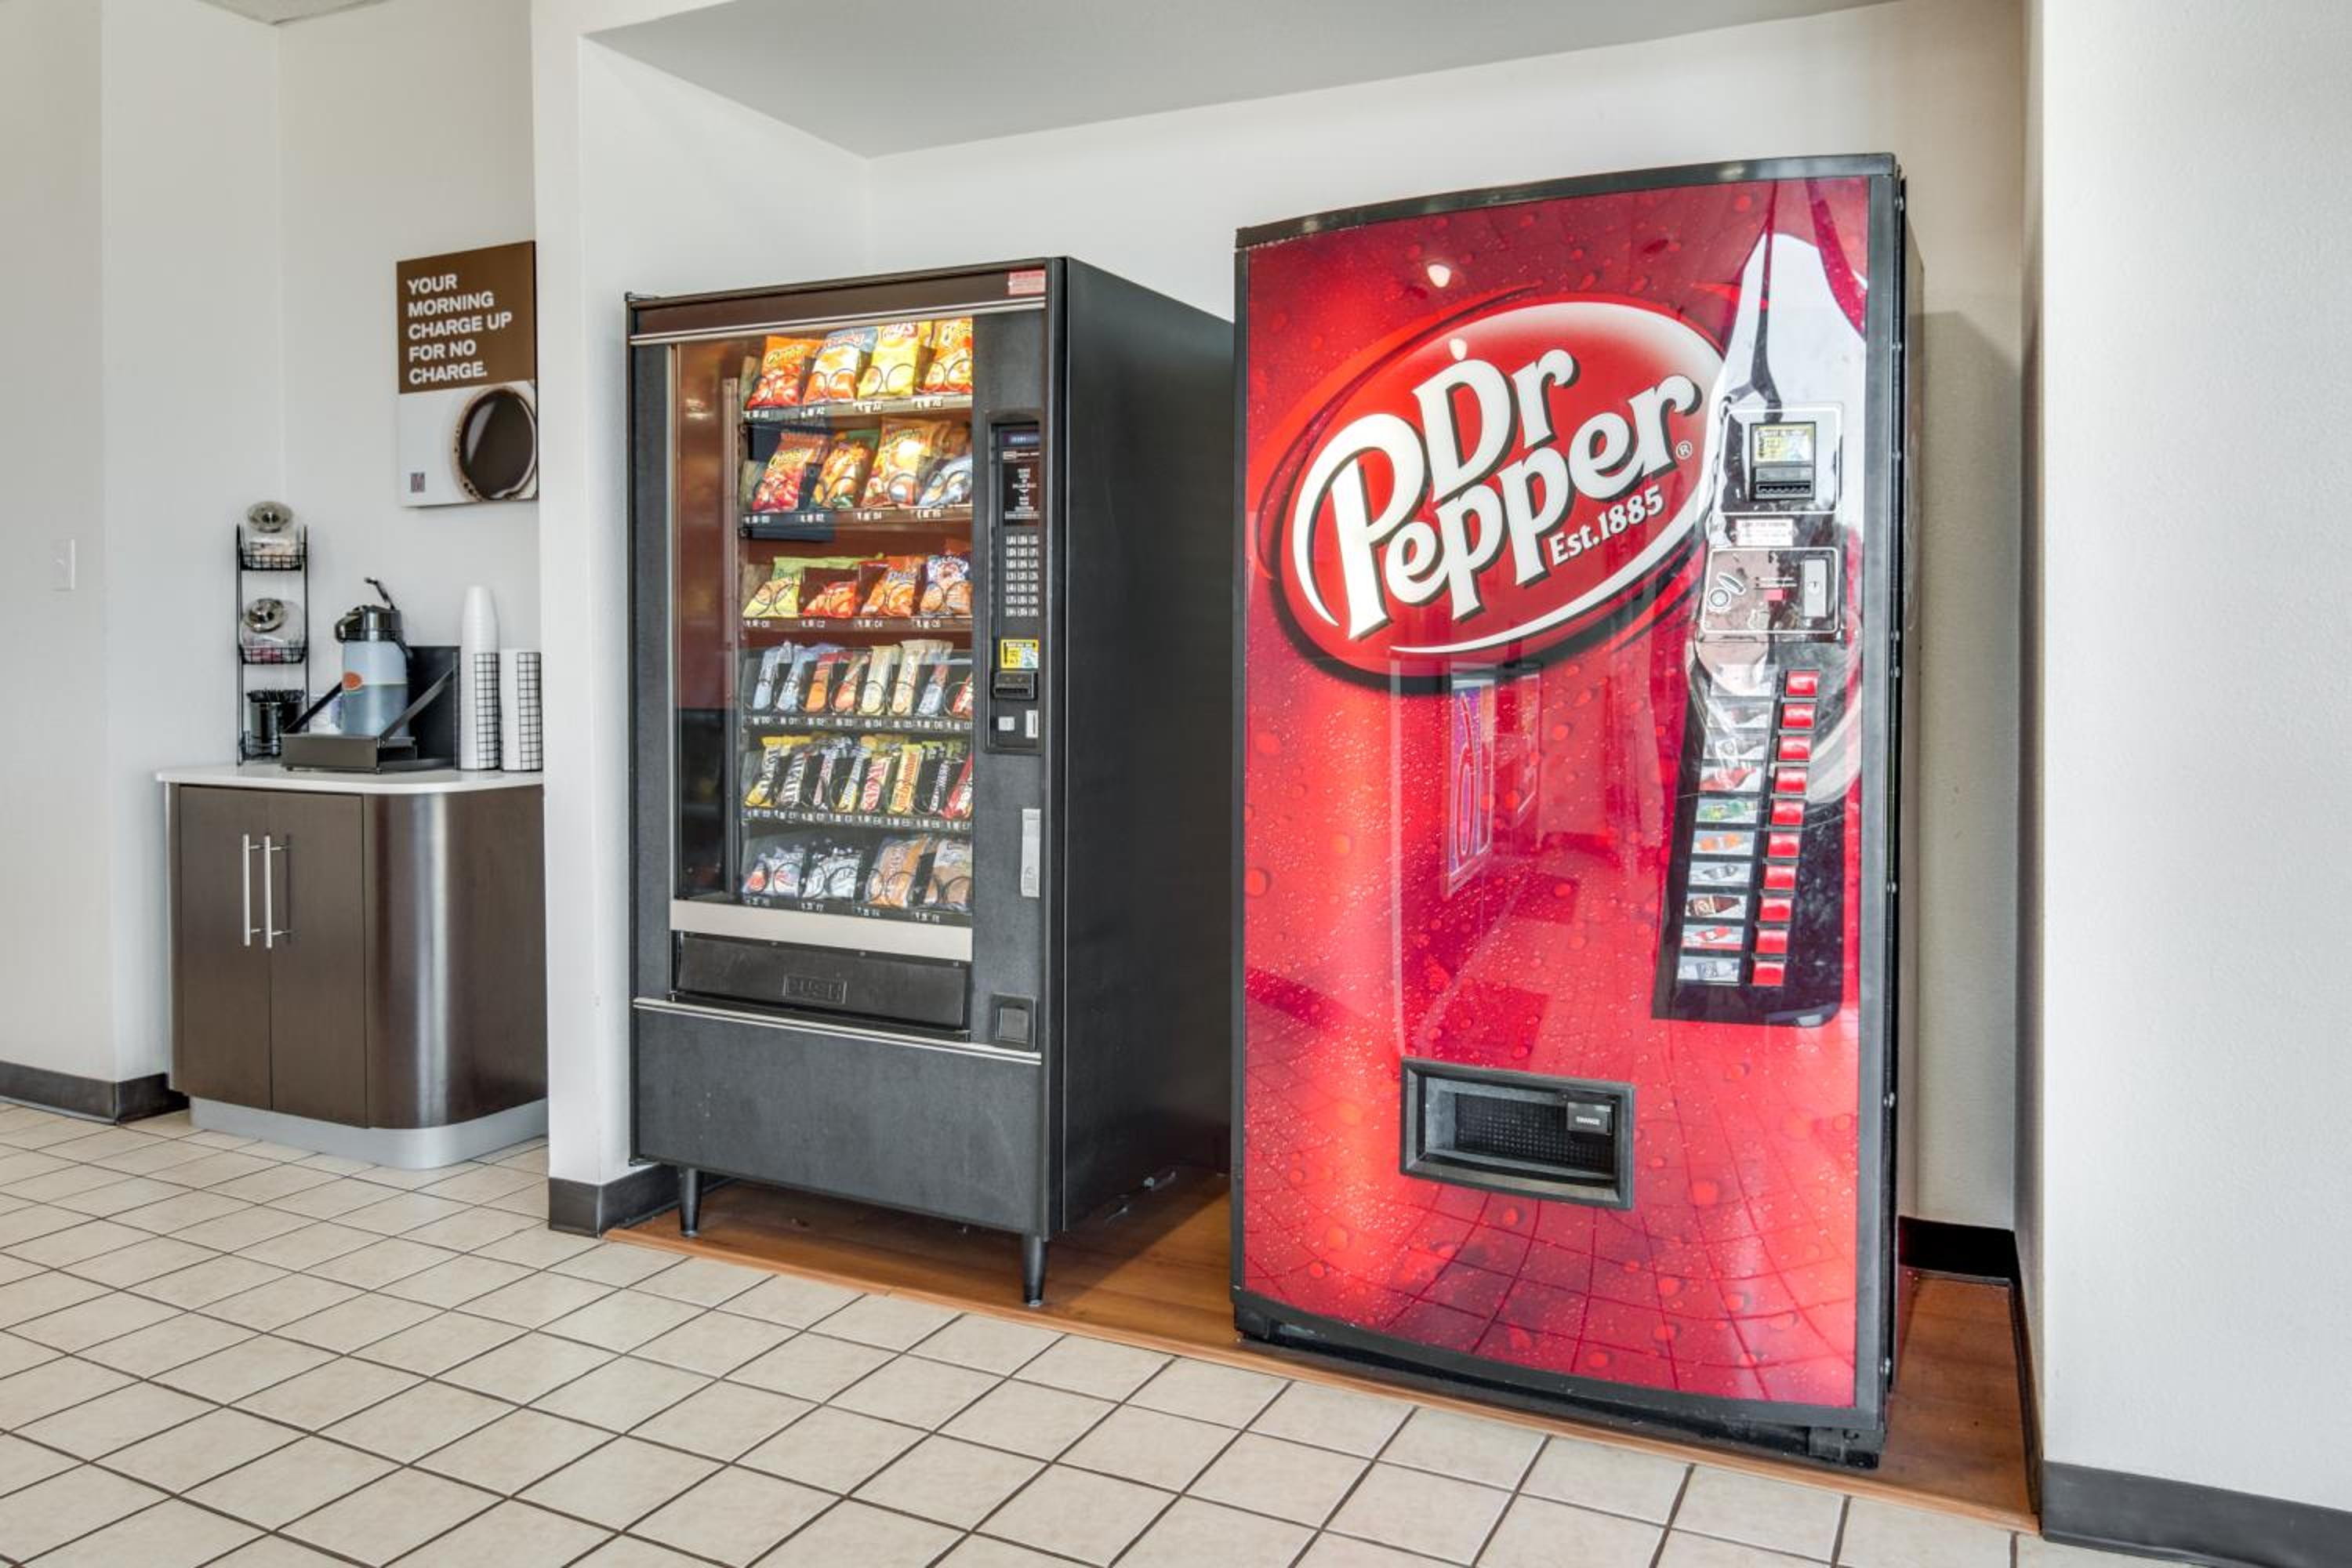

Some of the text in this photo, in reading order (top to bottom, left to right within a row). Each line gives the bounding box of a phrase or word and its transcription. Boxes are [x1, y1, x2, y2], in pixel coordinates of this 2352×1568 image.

[407, 274, 457, 295] YOUR
[408, 291, 494, 318] MORNING
[408, 312, 512, 340] CHARGE UP
[408, 339, 477, 362] FOR NO
[408, 361, 488, 384] CHARGE.
[1412, 348, 1576, 503] Dr
[1292, 374, 1700, 641] Pepper
